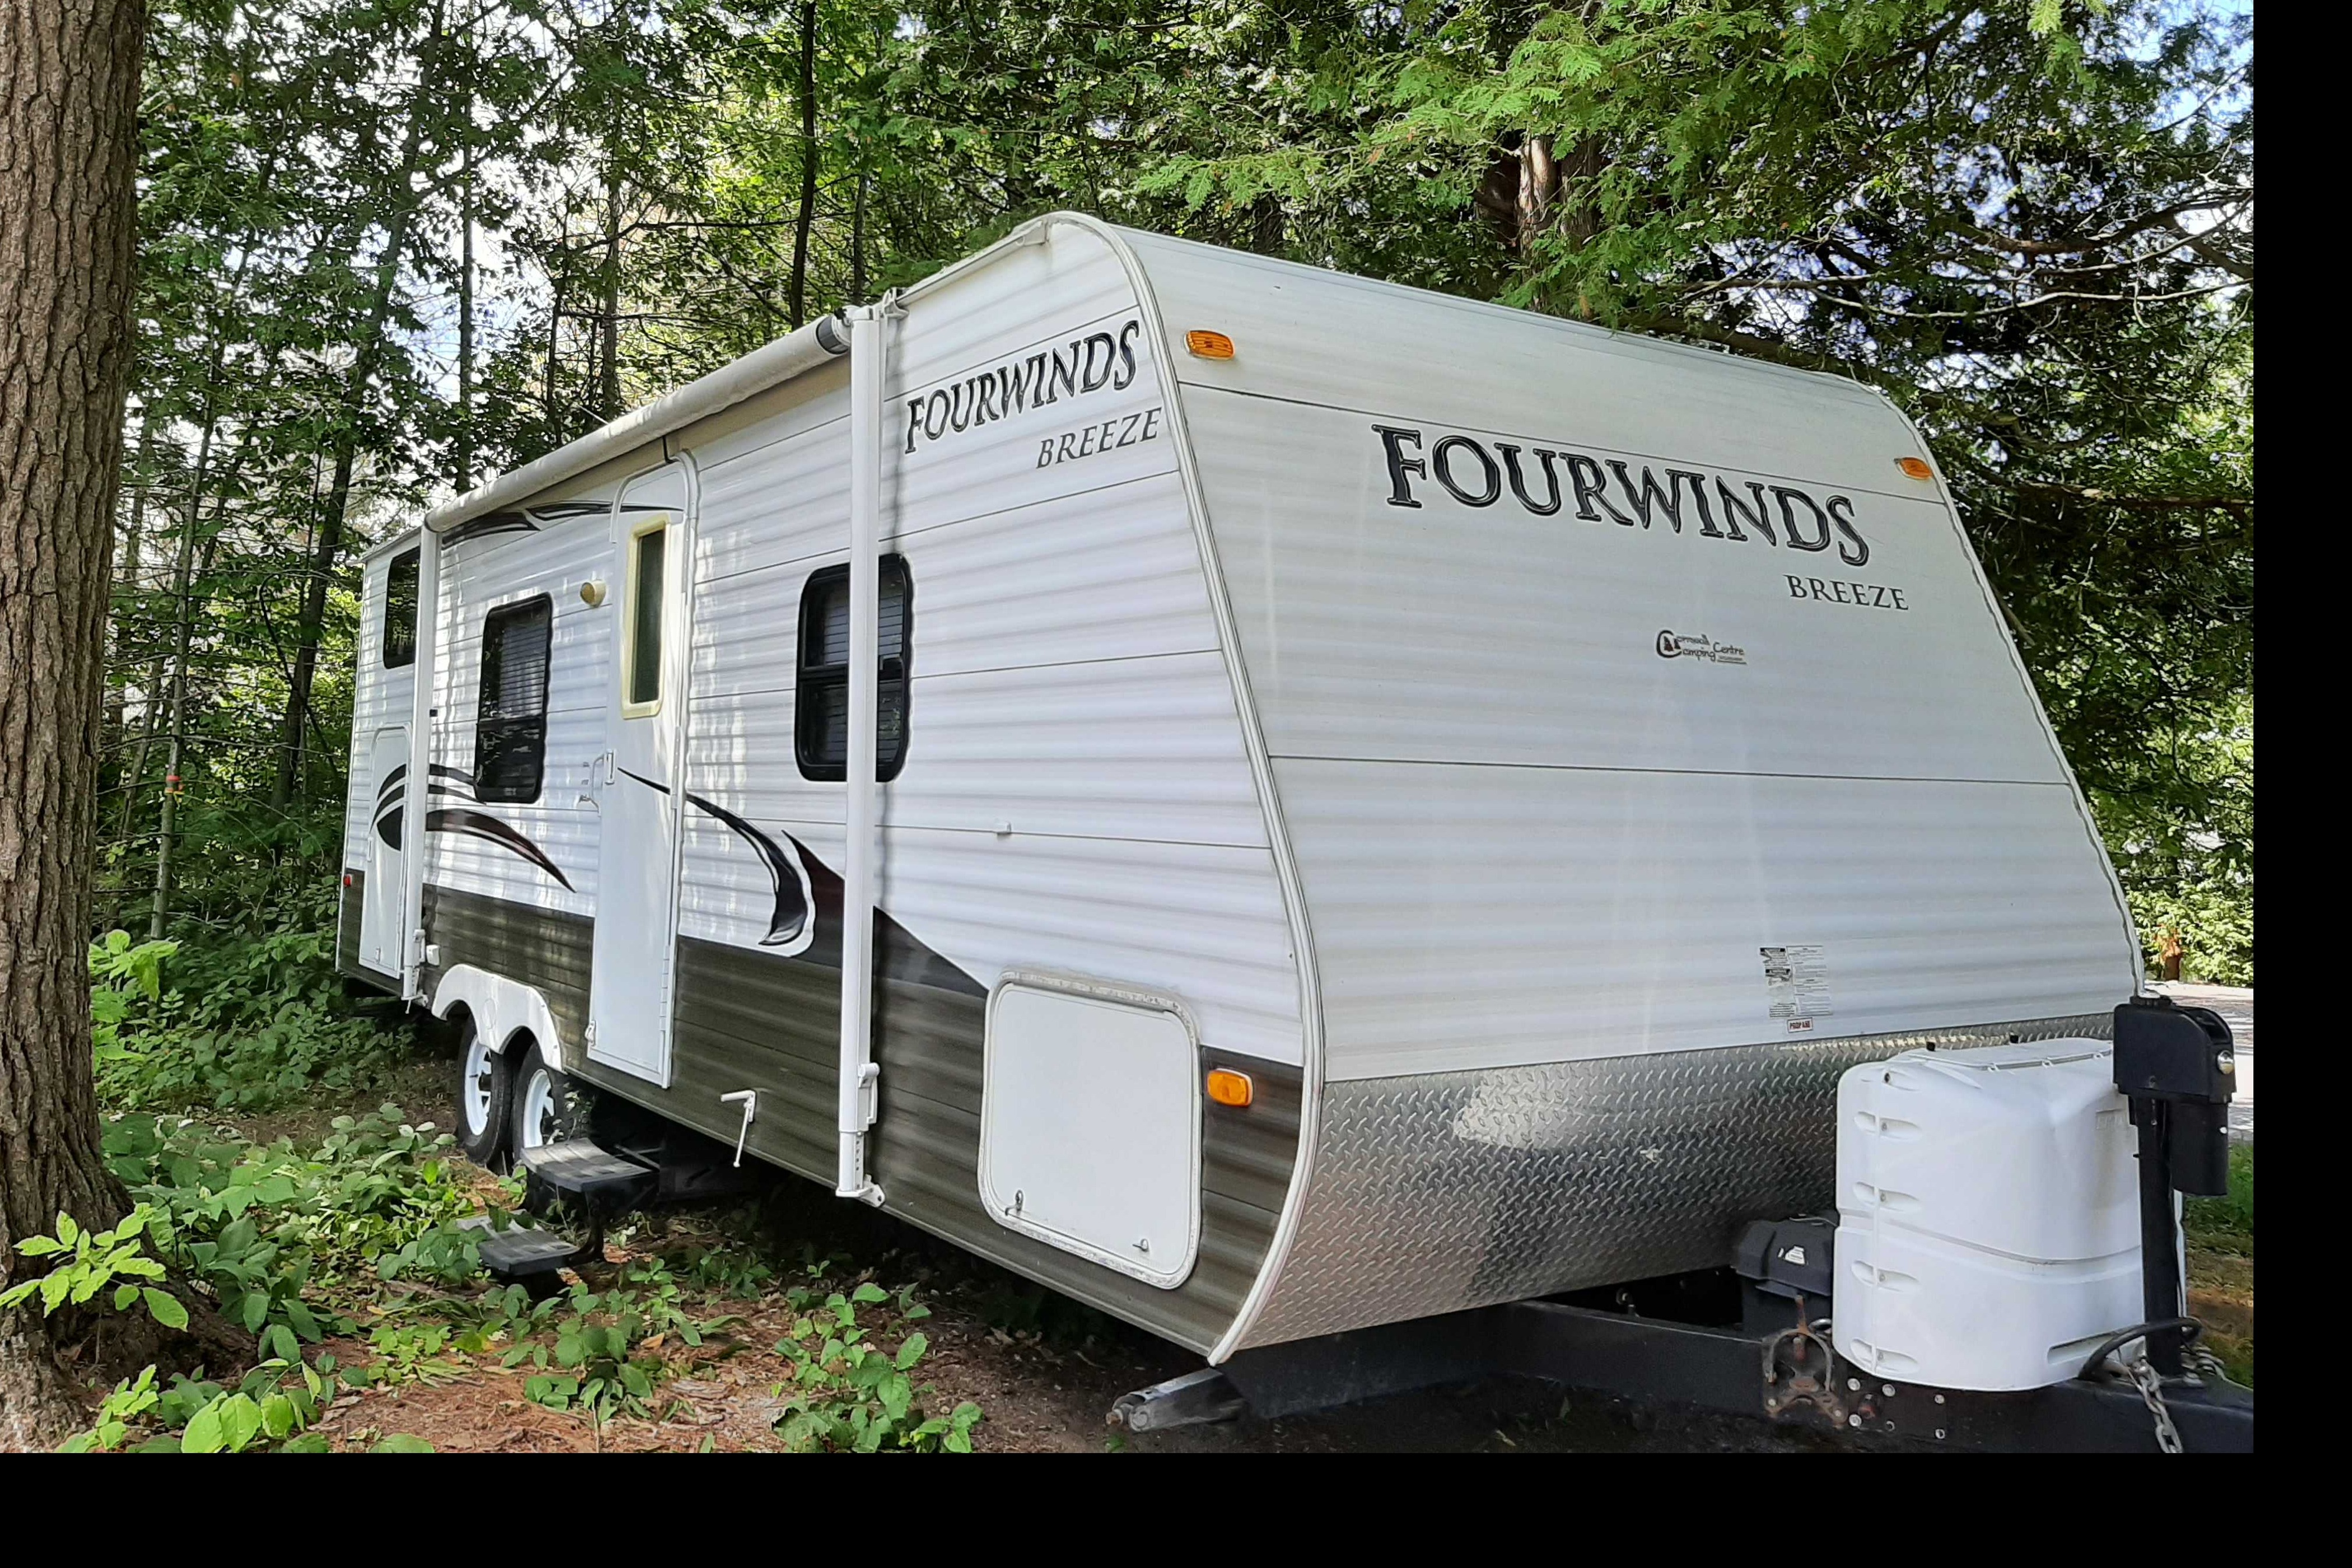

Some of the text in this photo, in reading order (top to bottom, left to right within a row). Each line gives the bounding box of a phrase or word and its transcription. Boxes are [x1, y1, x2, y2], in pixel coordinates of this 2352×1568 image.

[905, 320, 1139, 454] FOURWINDS
[1036, 407, 1161, 468] BREEZE
[1371, 424, 1870, 567] FOURWINDS
[1783, 575, 1909, 611] BREEZE
[1713, 642, 1745, 655] Centre
